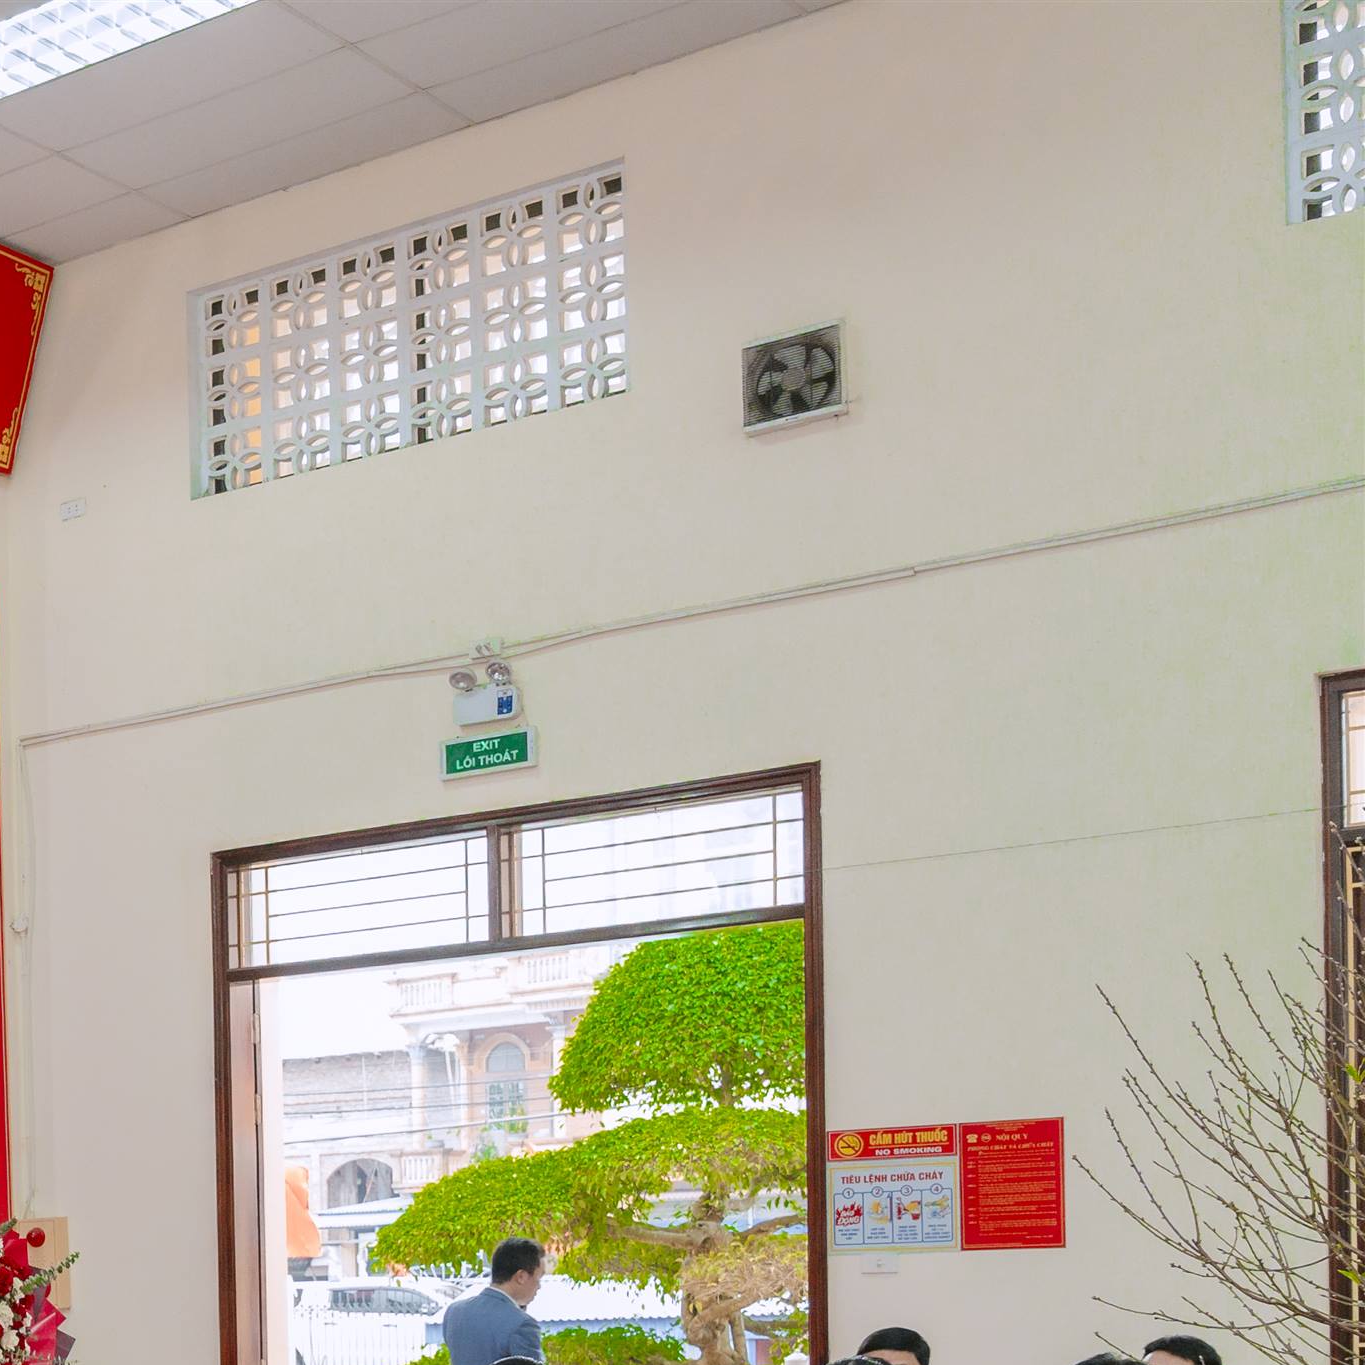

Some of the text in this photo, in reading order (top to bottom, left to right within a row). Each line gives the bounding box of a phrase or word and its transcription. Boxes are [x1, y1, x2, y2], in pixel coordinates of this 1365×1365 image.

[472, 739, 500, 753] EXIT
[456, 748, 519, 770] LỐI THOÁT
[869, 1127, 948, 1145] CẤM HÚT THUỐC
[893, 1146, 942, 1155] SMOKING
[841, 1170, 943, 1185] TIÊU LỆNH CHỮA CHÁY
